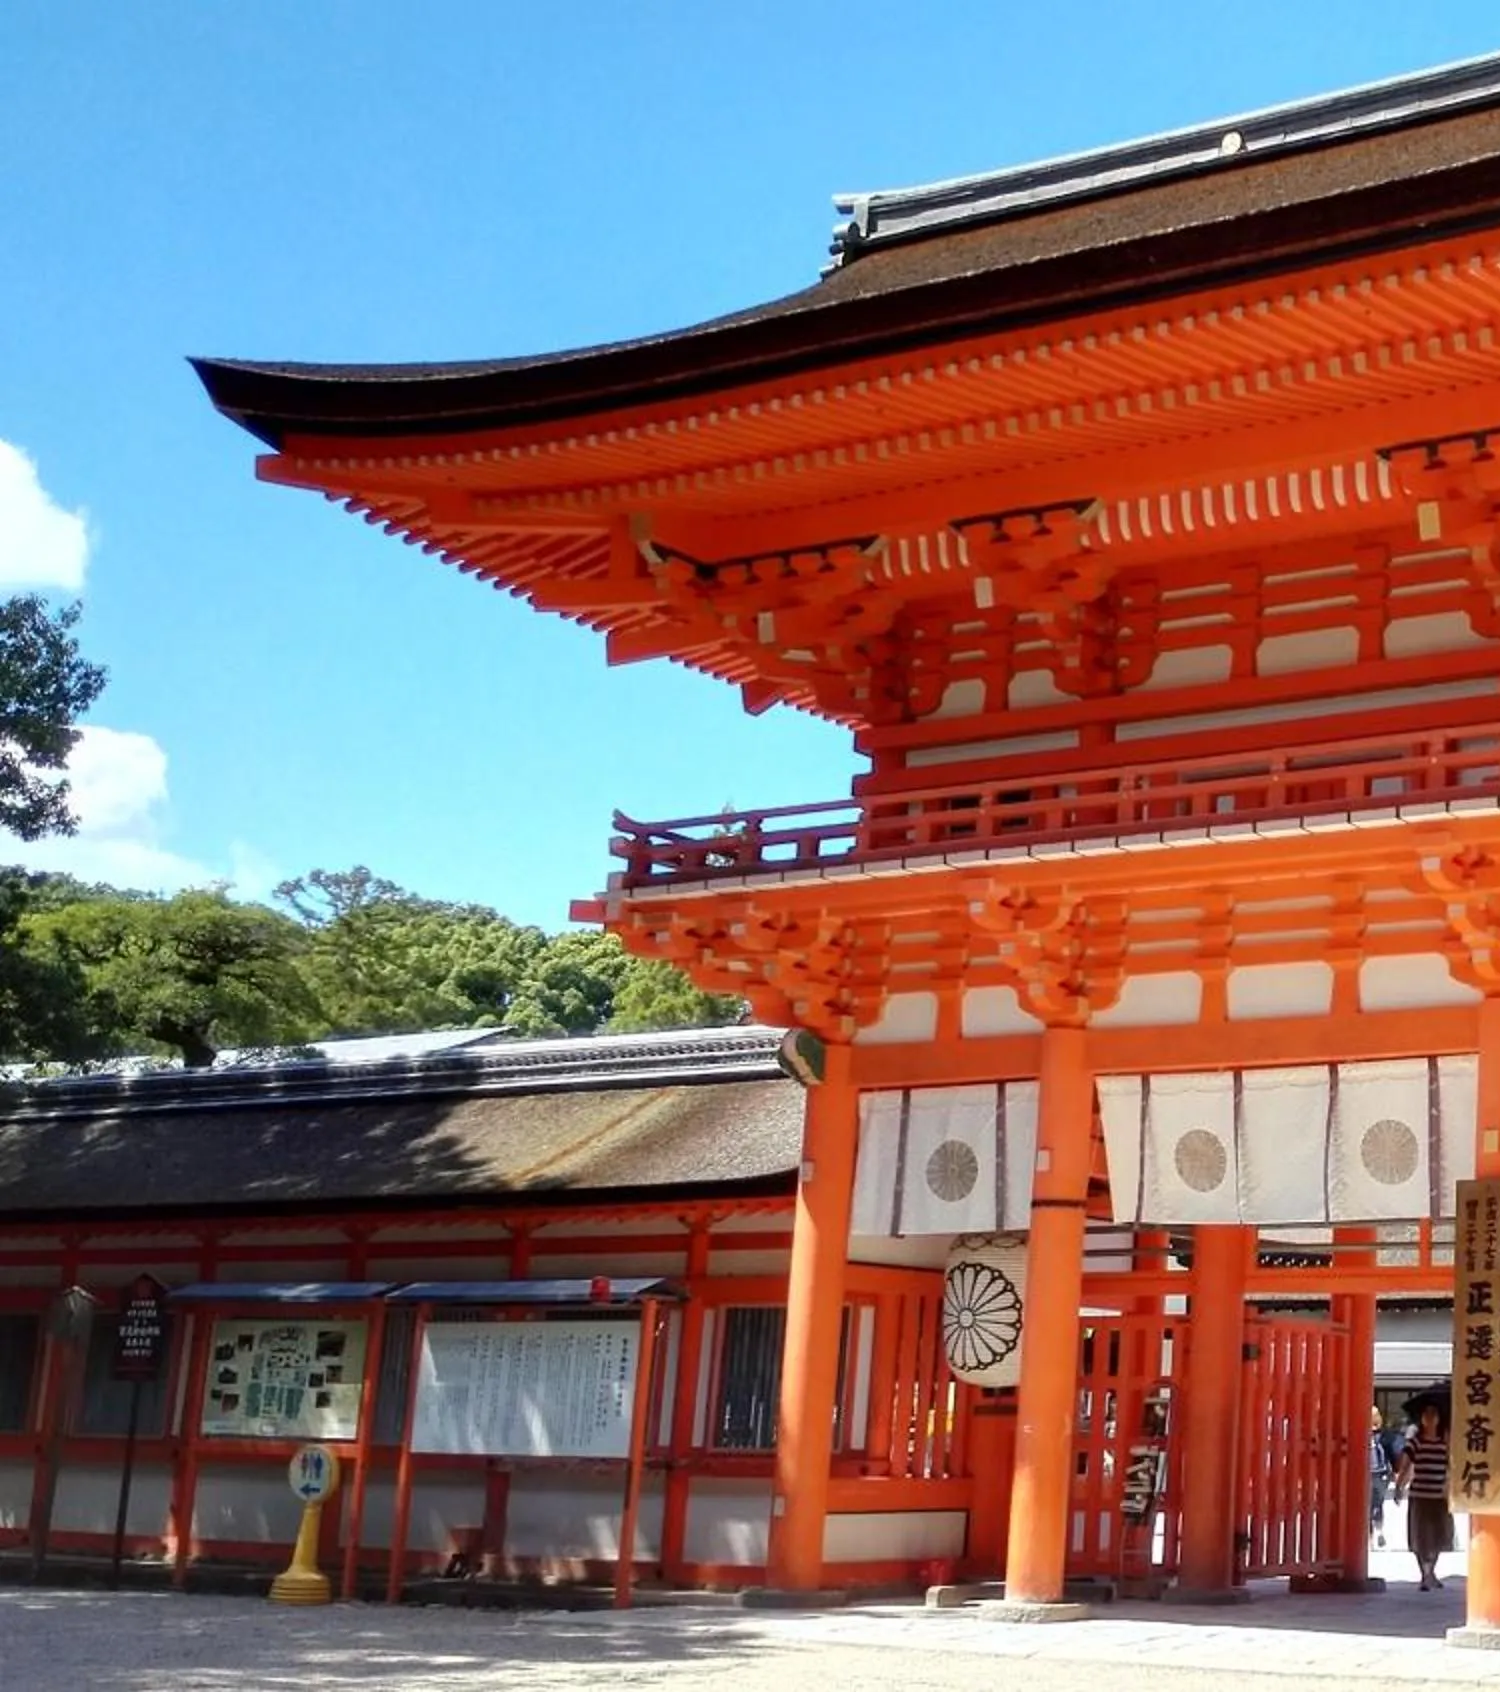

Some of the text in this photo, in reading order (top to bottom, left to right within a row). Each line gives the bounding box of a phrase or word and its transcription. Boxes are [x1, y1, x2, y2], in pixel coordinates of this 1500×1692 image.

[1462, 1281, 1494, 1499] 正遷宮斎行
